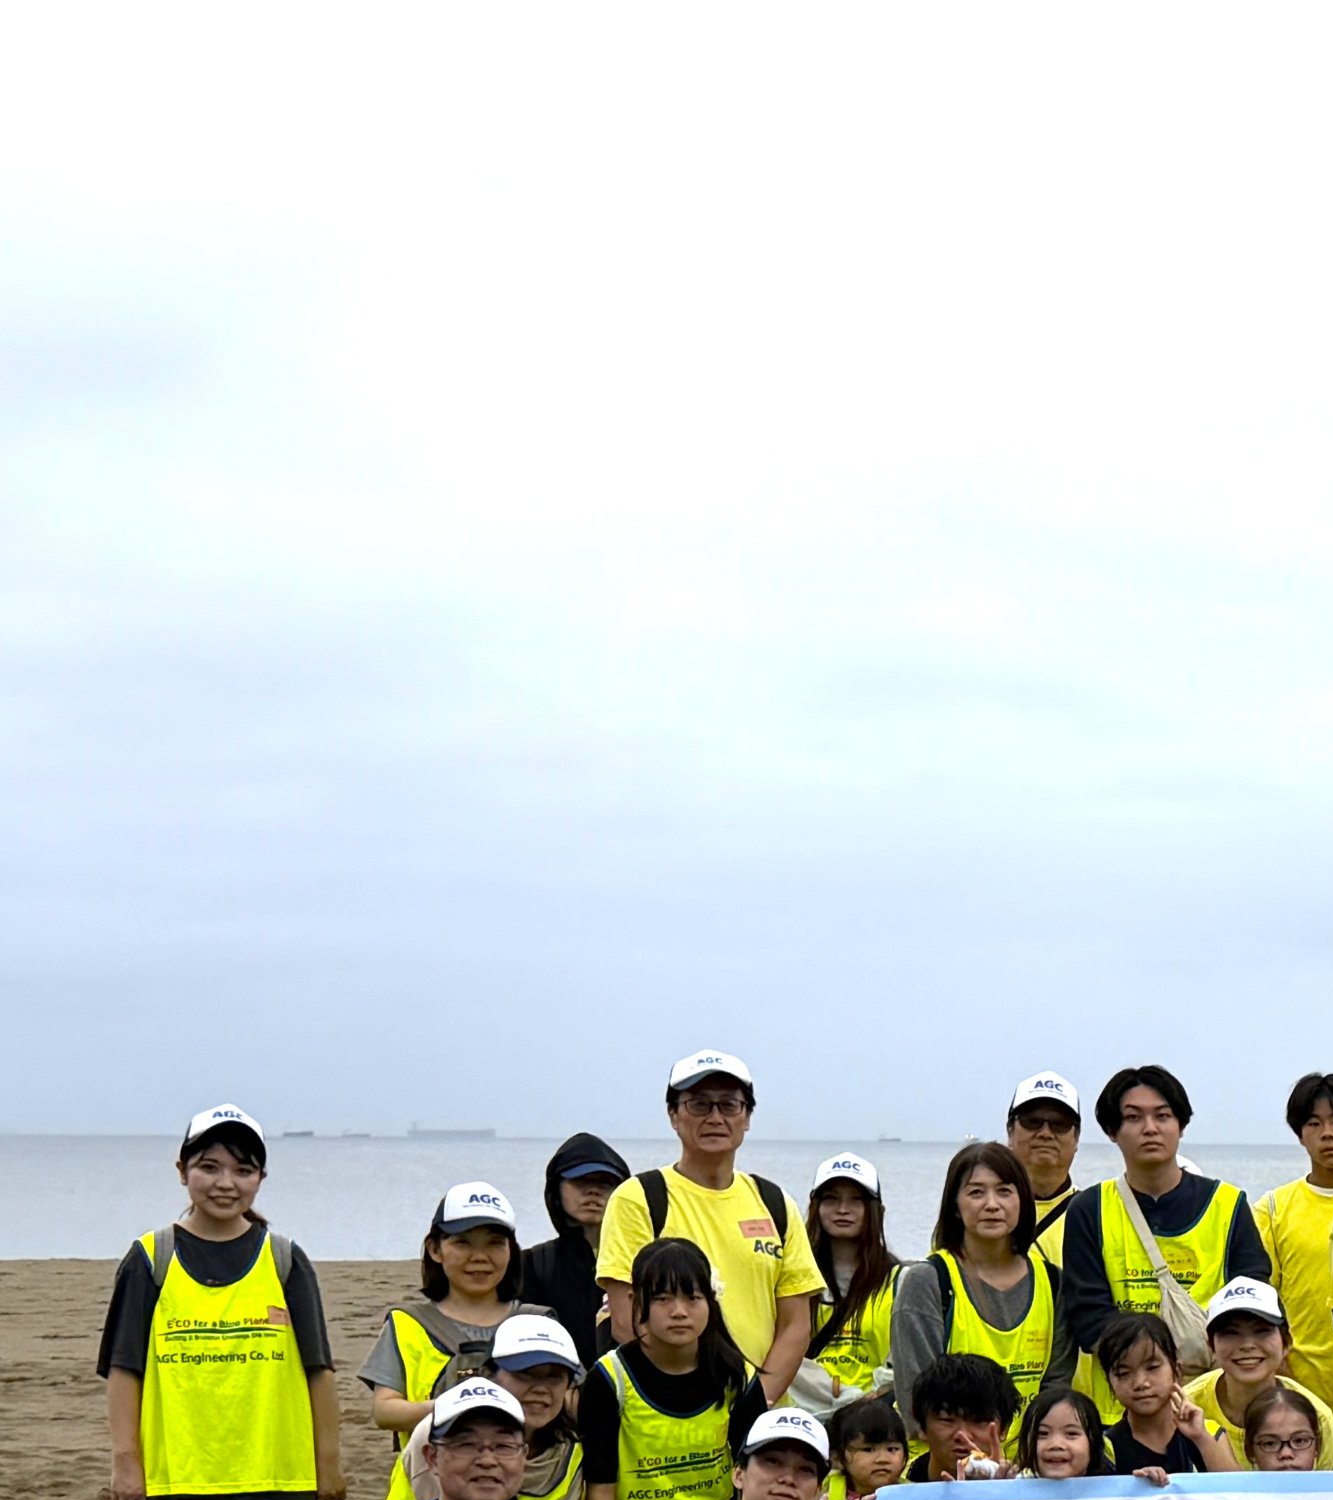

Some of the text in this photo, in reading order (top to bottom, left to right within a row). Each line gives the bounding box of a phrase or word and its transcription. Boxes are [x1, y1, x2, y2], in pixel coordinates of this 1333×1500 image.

[1034, 1080, 1063, 1092] AGC
[832, 1160, 861, 1172] AGC
[469, 1193, 501, 1207] AGC
[753, 1240, 784, 1259] AGC
[1224, 1286, 1257, 1300] AGC
[181, 1351, 247, 1365] Engineering
[459, 1386, 499, 1398] AGC
[776, 1415, 813, 1431] AGC
[627, 1479, 713, 1500] AGC Engineering
